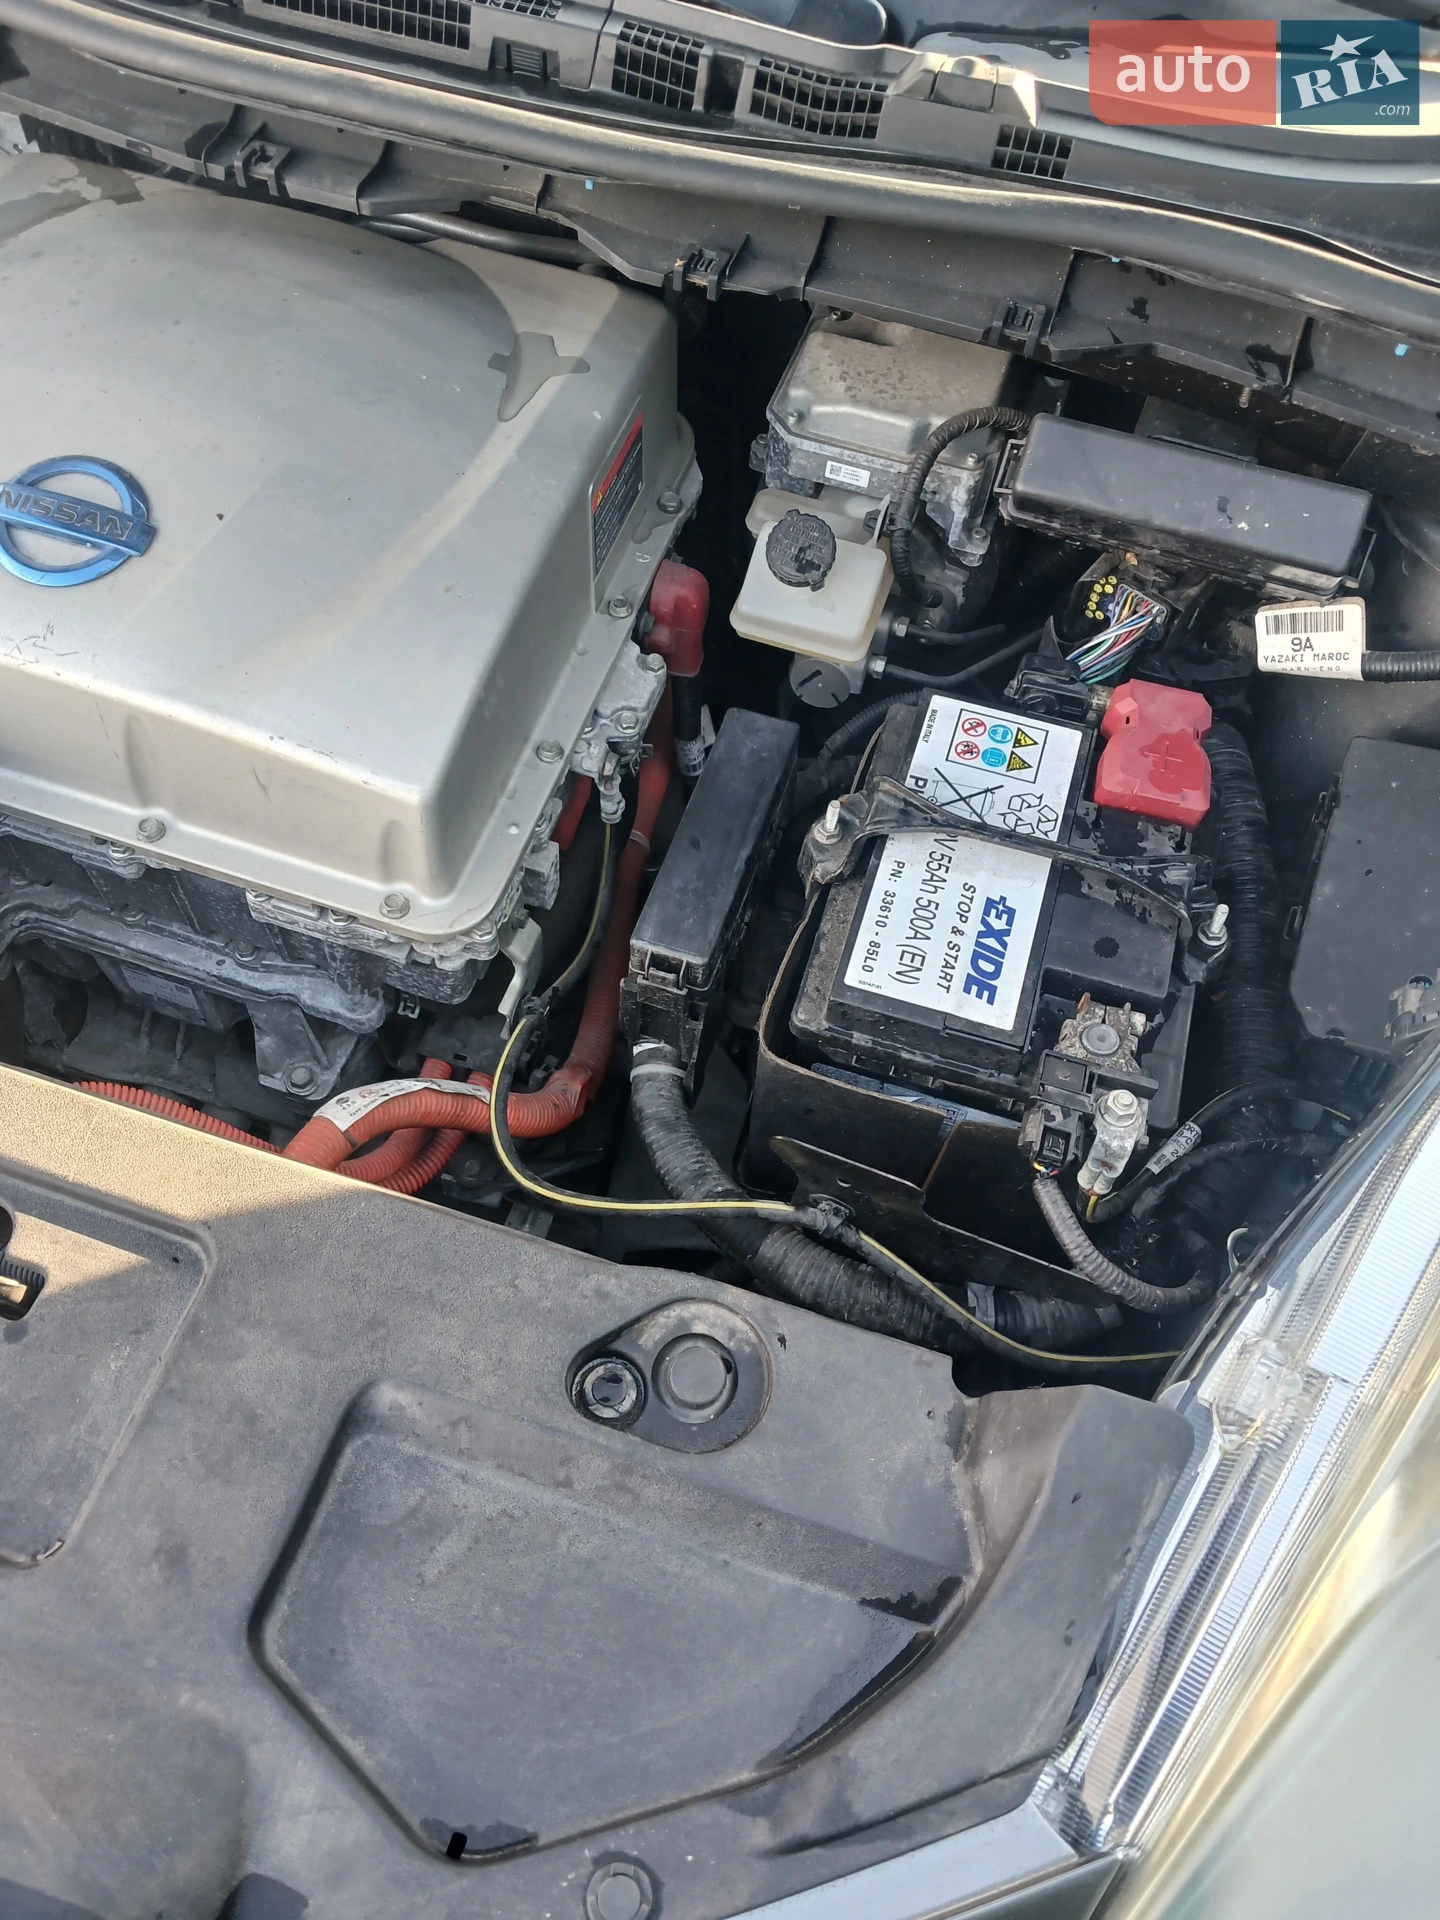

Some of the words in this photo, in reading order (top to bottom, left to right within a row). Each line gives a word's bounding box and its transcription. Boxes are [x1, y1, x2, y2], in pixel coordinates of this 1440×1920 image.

[0, 488, 133, 541] NISSAN
[1263, 654, 1304, 663] YAZAKI
[1313, 652, 1350, 663] MAROC
[1291, 637, 1314, 653] 9A
[928, 709, 938, 723] MADE
[922, 729, 932, 743] ITALY
[889, 859, 906, 883] PN:
[919, 850, 953, 895] 55Ah
[875, 890, 897, 929] 33610
[905, 896, 940, 941] 500A
[956, 882, 977, 924] STOP
[950, 925, 965, 937] &
[962, 894, 1017, 1006] EXIDE
[862, 940, 882, 973] 85L0
[888, 944, 928, 985] (EN)
[937, 940, 961, 994] START
